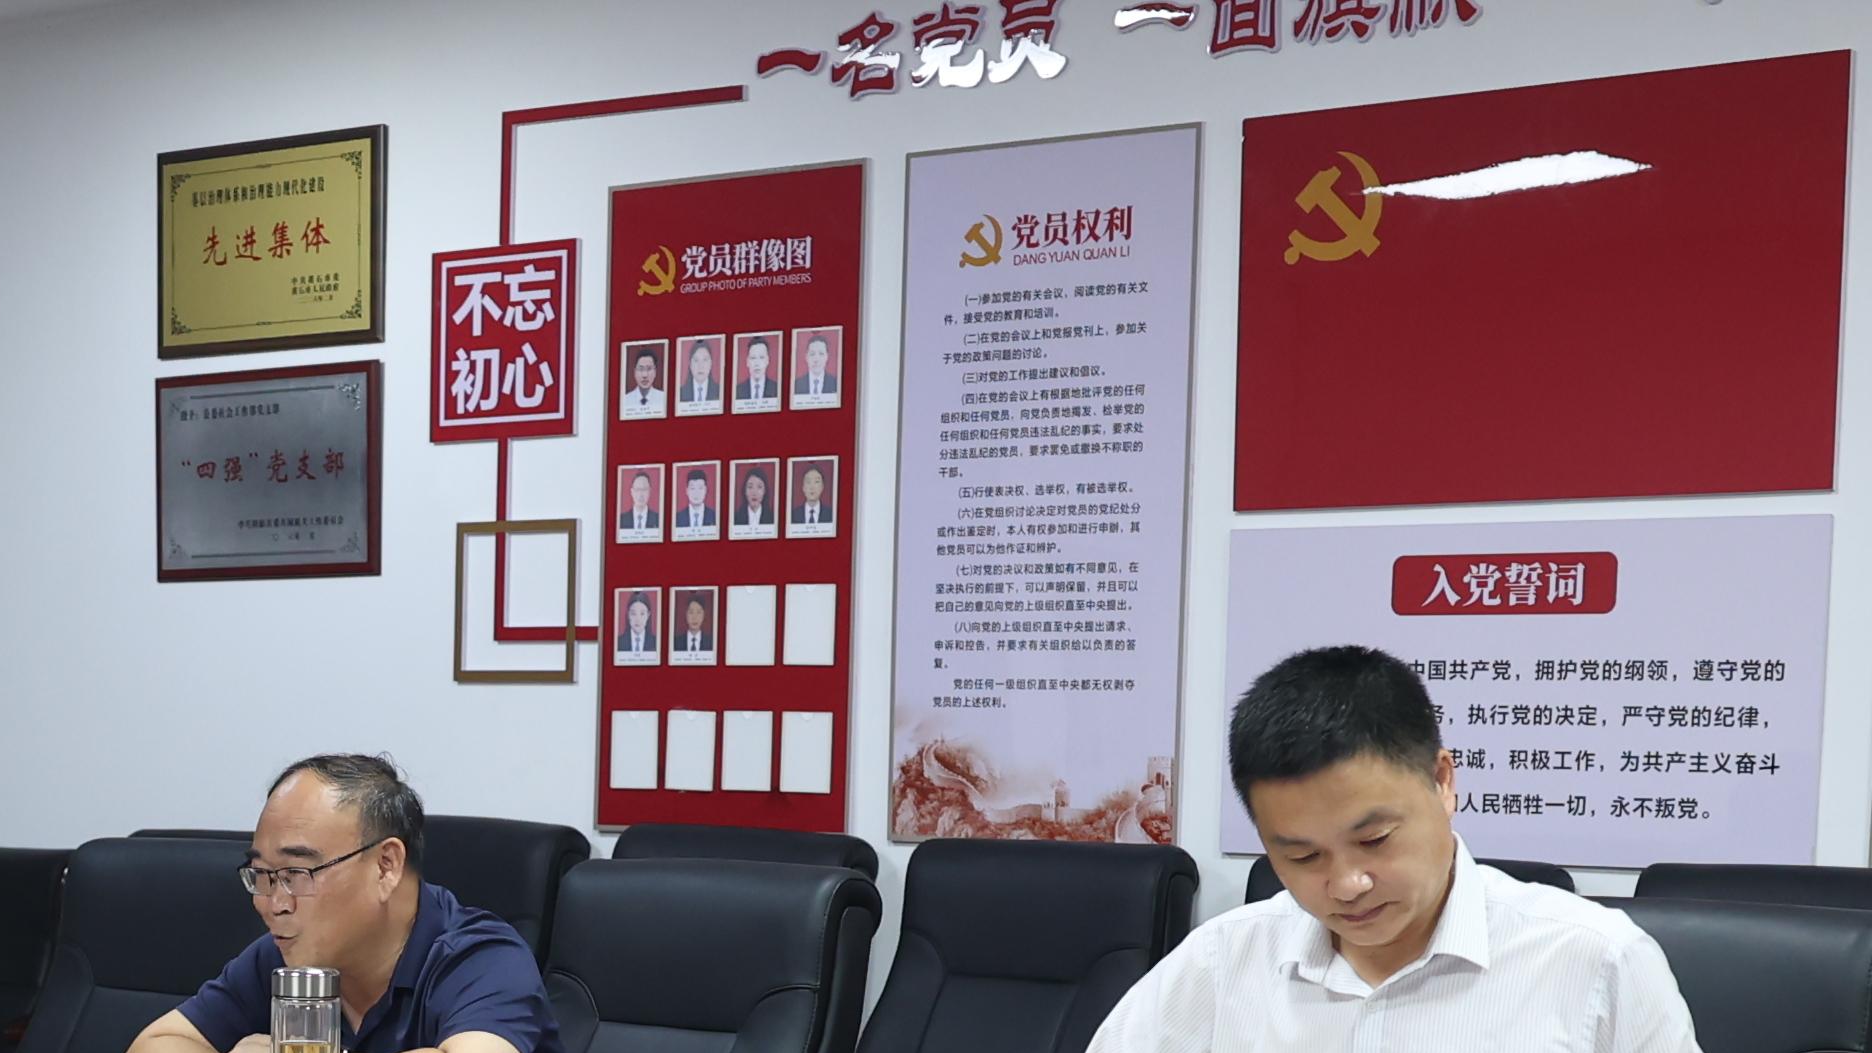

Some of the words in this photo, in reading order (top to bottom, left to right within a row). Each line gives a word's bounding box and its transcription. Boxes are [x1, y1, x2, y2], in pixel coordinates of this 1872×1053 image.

[757, 0, 1066, 100] 一名党员
[202, 217, 331, 267] 先进集体
[1010, 204, 1133, 250] 党员权利
[681, 235, 813, 280] 党员群像图
[1013, 252, 1047, 266] DANG
[1049, 250, 1080, 263] YUAN
[1083, 247, 1117, 261] QUAN
[1120, 245, 1131, 258] LI
[451, 263, 556, 337] 不忘
[680, 281, 708, 294] GROUP
[708, 279, 736, 292] PHOTO
[737, 278, 748, 290] OF
[748, 276, 773, 288] PARTY
[773, 273, 812, 286] MEMBERS
[450, 342, 555, 415] 初心
[1420, 561, 1586, 607] 入党誓词
[1454, 793, 1711, 820] 人民牺牲一切，永不叛党。
